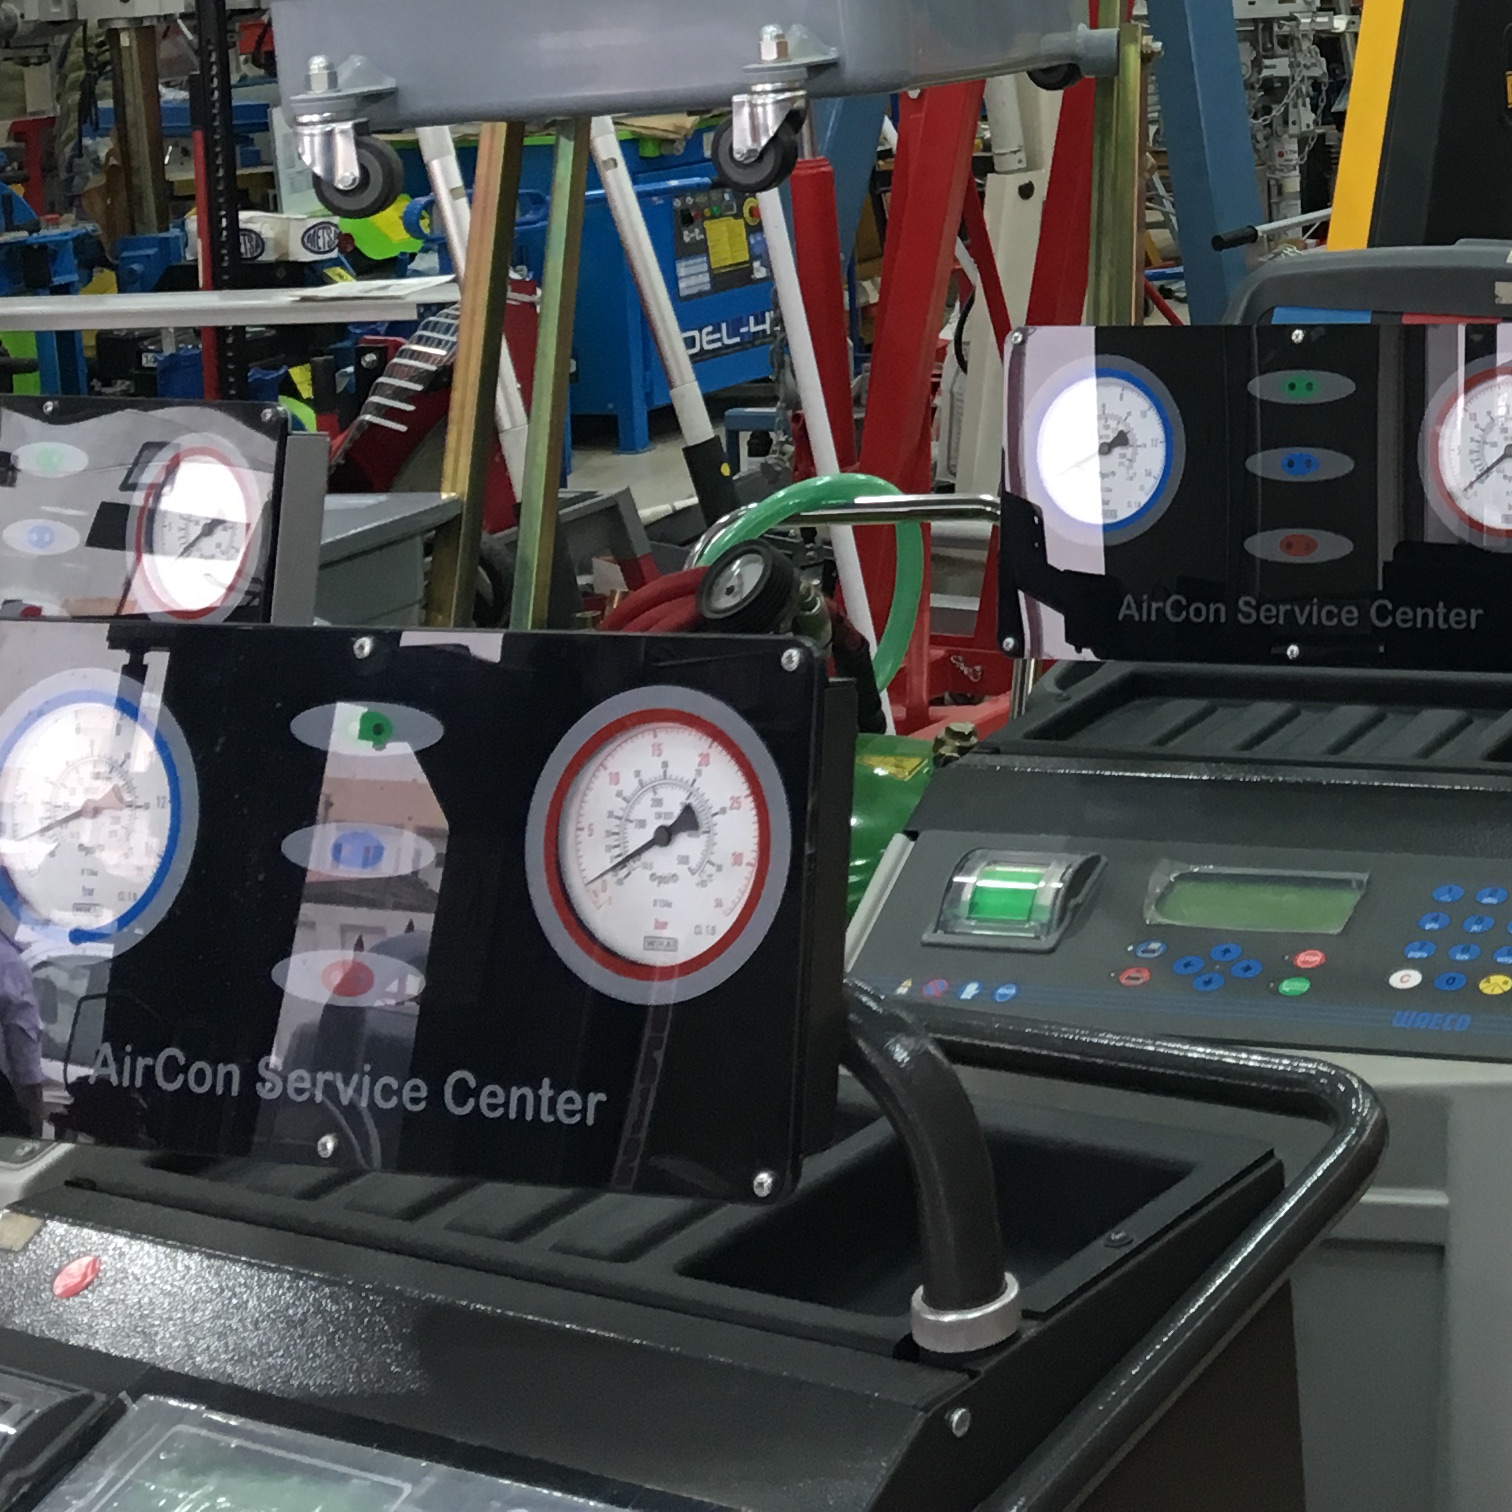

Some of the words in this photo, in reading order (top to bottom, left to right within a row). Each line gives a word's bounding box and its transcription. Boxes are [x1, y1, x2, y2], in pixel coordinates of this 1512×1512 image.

[1118, 594, 1226, 623] AirCon
[1237, 595, 1359, 627] Service
[1370, 599, 1484, 629] Center
[651, 743, 663, 757] 15
[1400, 974, 1412, 984] C
[1392, 1010, 1471, 1031] WAECO
[89, 1043, 241, 1097] AirCon
[256, 1055, 429, 1112] Service
[444, 1069, 607, 1126] Center
